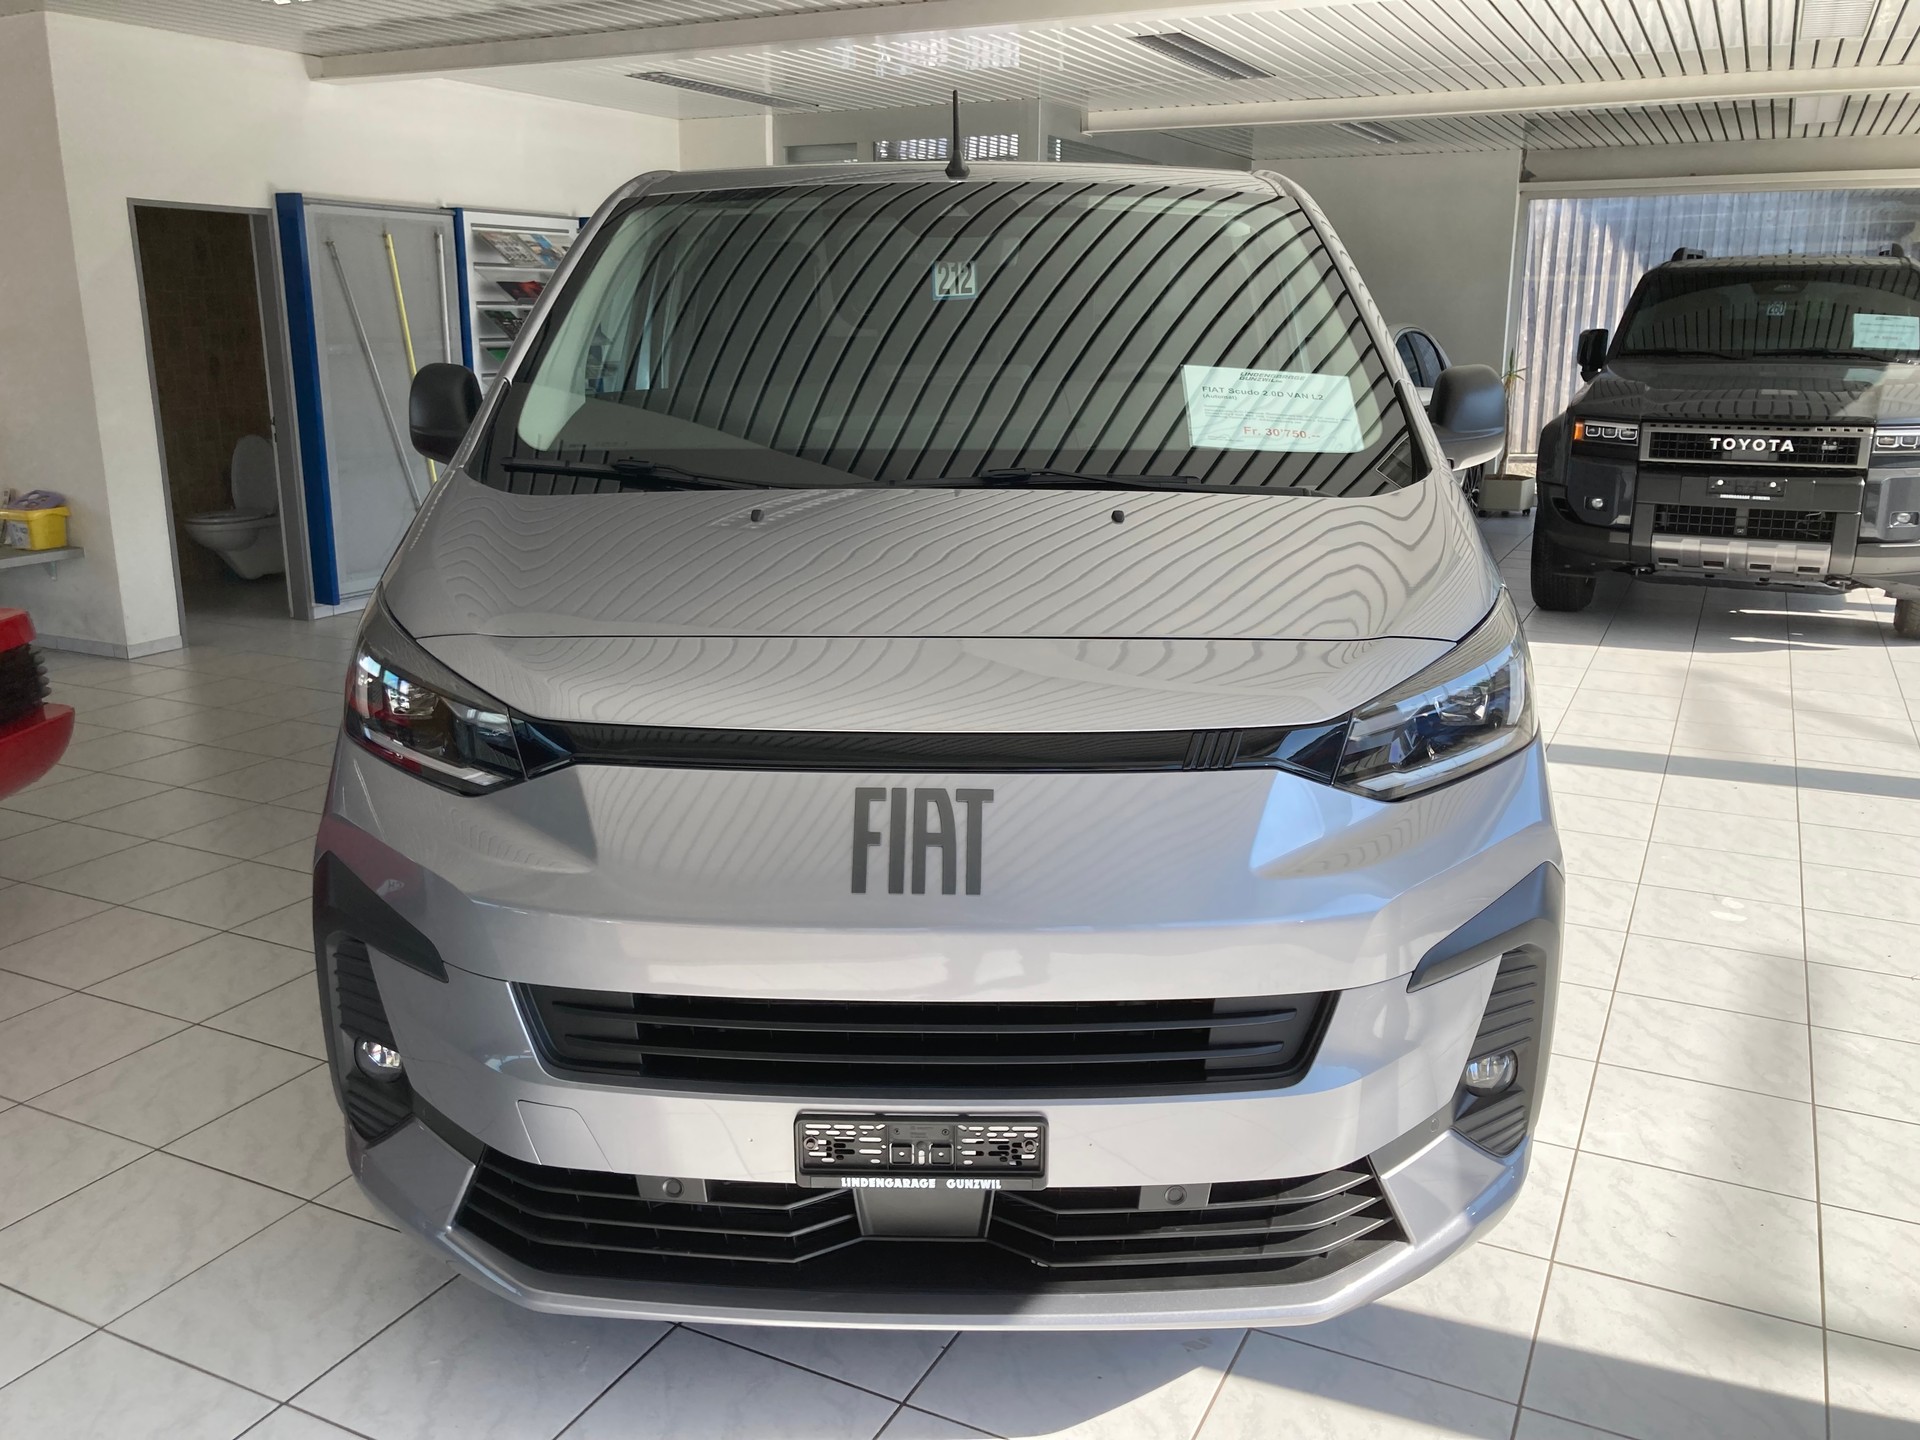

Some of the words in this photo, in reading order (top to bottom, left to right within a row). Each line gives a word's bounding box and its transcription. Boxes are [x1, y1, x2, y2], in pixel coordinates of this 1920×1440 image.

[938, 261, 972, 295] 212
[1202, 386, 1224, 394] FIAT
[1228, 388, 1260, 396] Scudo
[1262, 390, 1284, 398] 2.0D
[1243, 426, 1261, 436] Fr.
[1709, 437, 1795, 452] TOYOTA
[851, 787, 994, 895] FIAT
[840, 1177, 936, 1189] LINDENGARAGE
[945, 1178, 1002, 1190] GUNZWIL
